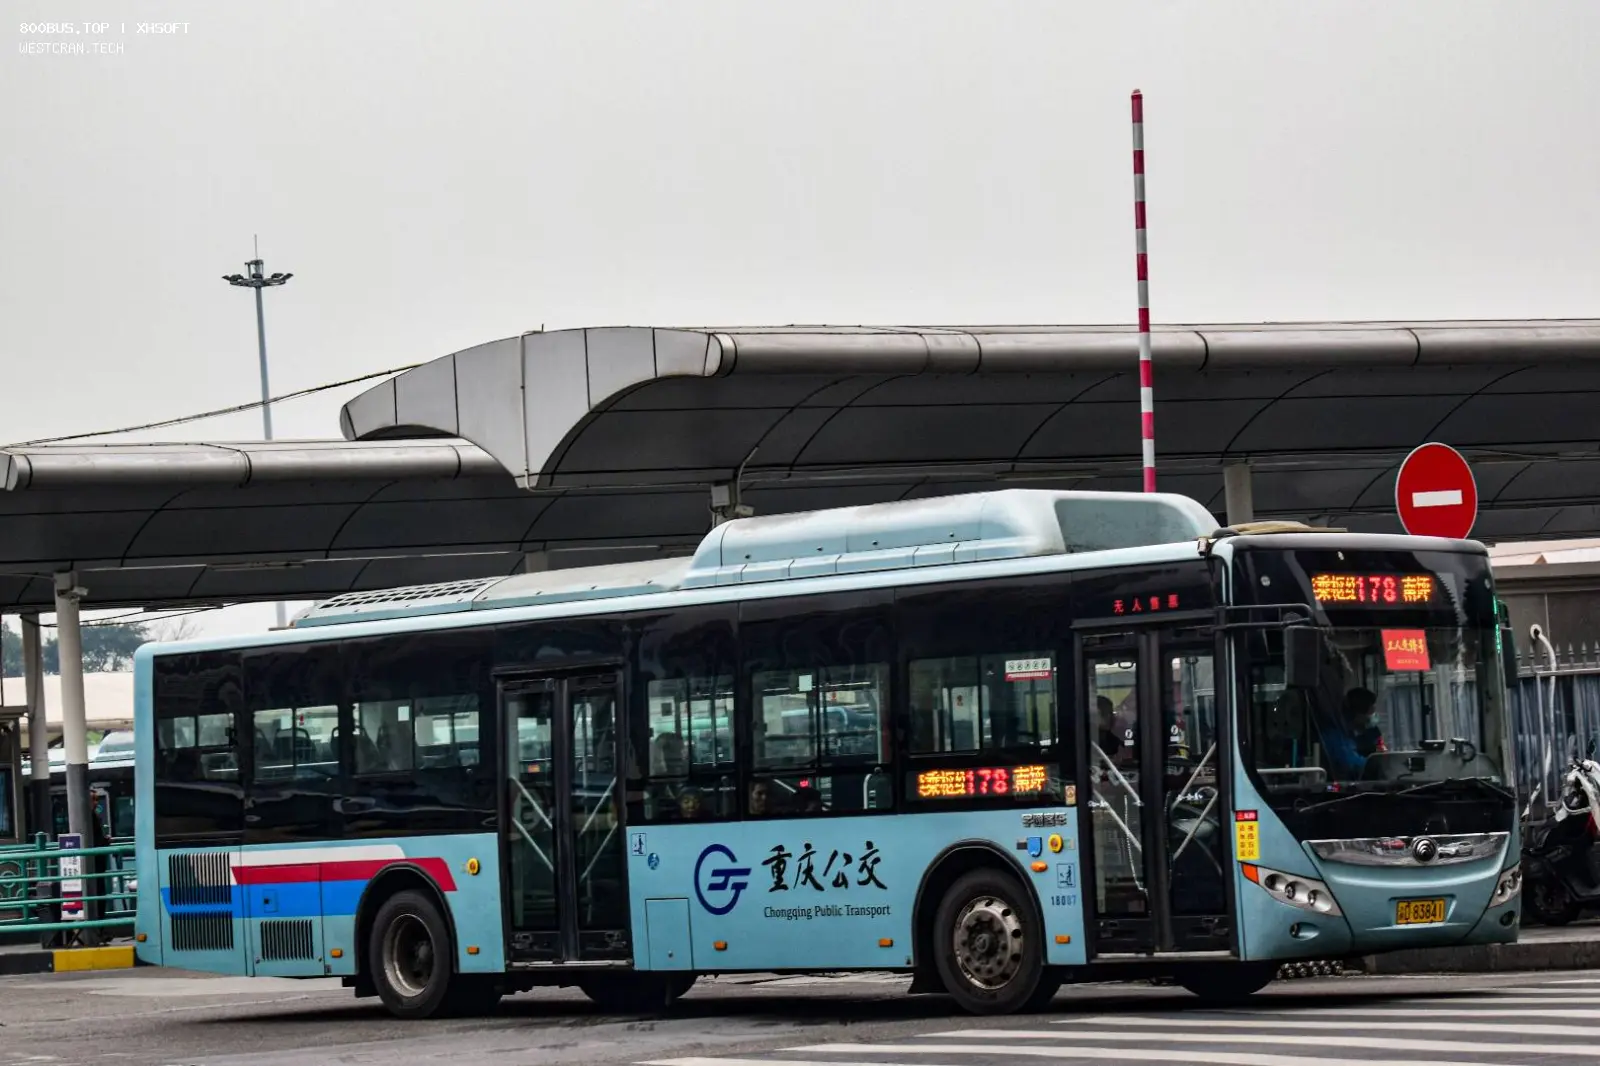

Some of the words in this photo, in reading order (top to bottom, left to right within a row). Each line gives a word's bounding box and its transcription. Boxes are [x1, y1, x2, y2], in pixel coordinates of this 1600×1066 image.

[1356, 576, 1397, 602] 178
[966, 768, 1008, 795] 178
[761, 840, 888, 893] 重庆公交
[763, 906, 812, 920] Chongqing
[815, 905, 843, 916] Public
[845, 904, 891, 917] Transport
